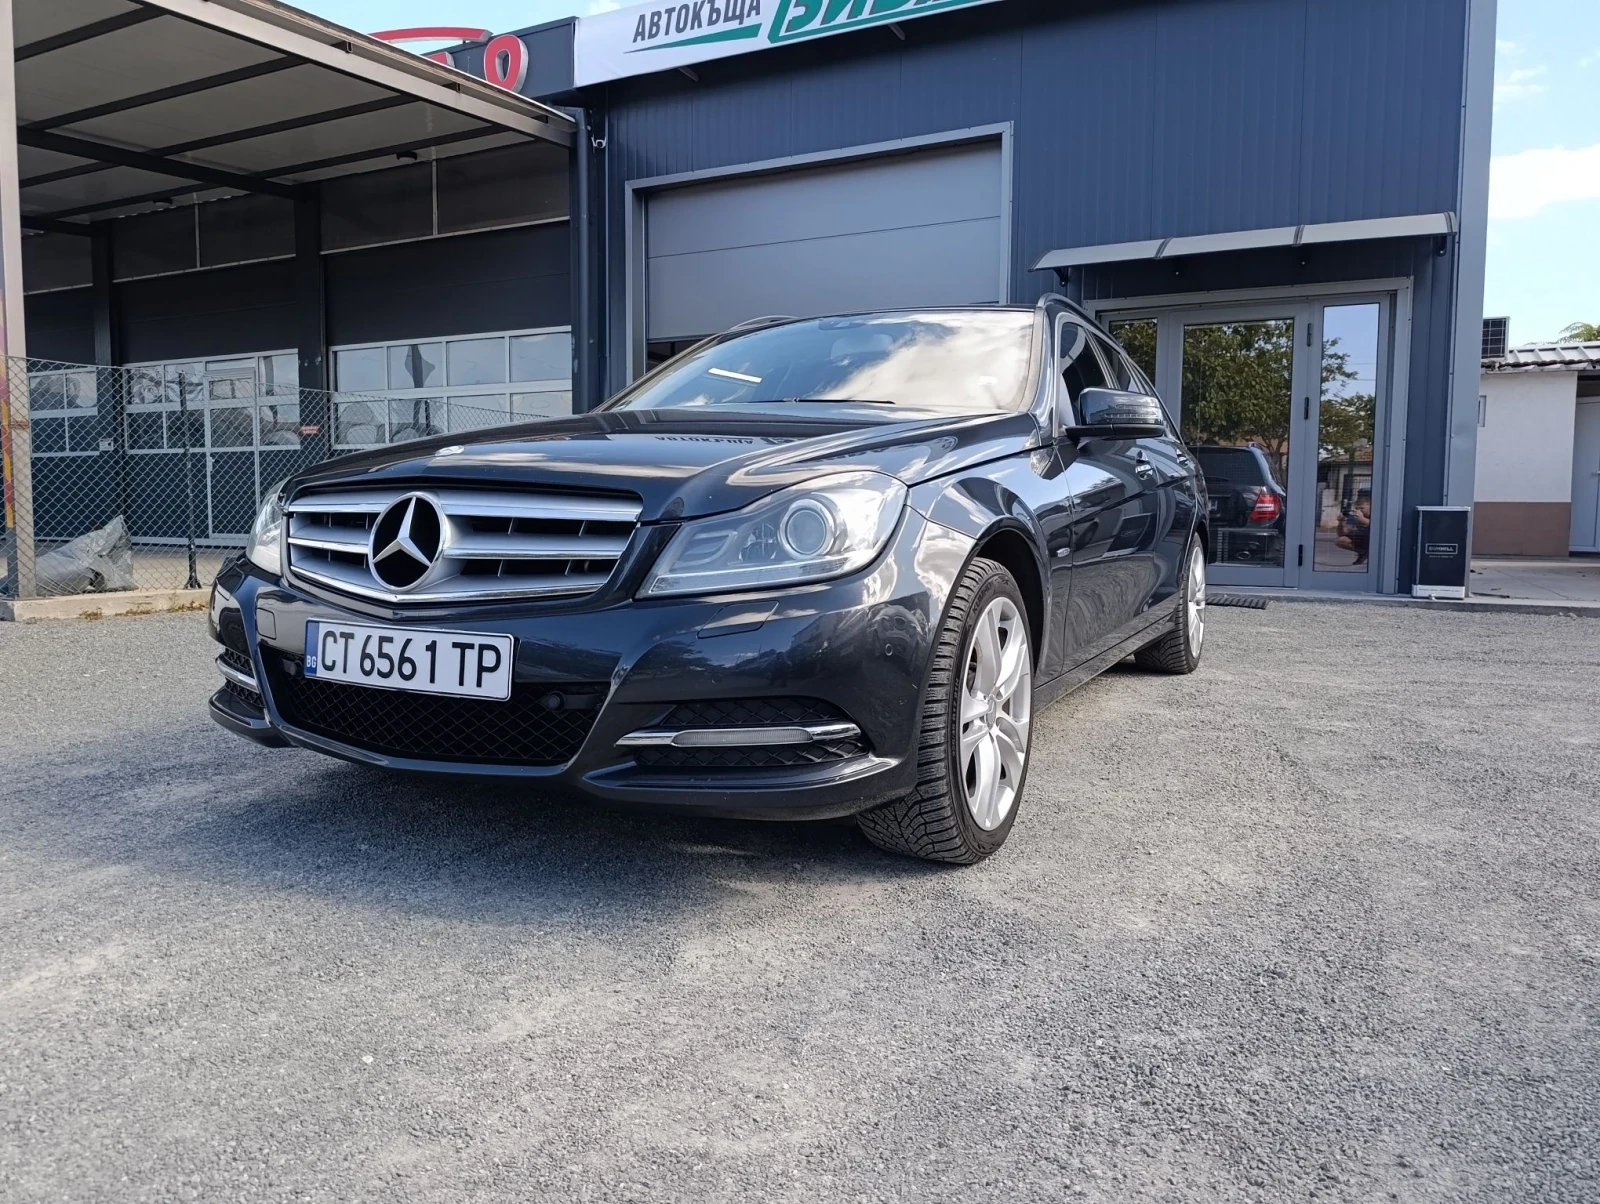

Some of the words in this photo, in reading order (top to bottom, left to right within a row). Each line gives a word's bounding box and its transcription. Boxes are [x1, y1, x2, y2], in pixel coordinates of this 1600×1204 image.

[632, 0, 761, 43] АВТОКЪЩА
[306, 656, 317, 668] BG
[360, 634, 437, 684] 6561
[451, 641, 501, 688] TP
